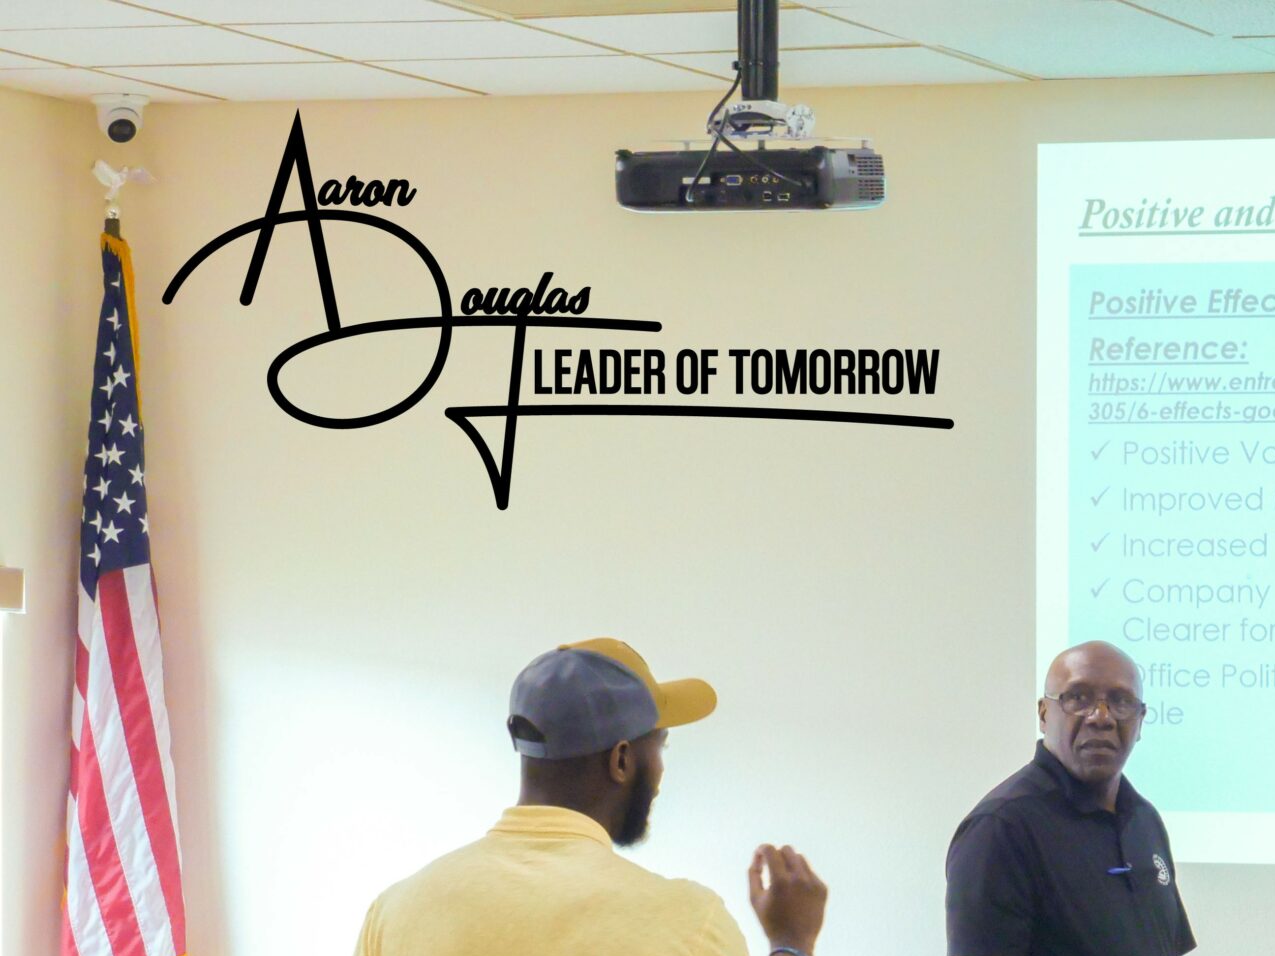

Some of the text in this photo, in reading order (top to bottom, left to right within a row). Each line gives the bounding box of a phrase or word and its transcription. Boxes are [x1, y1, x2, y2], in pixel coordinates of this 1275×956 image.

[1079, 196, 1204, 230] Positive
[1089, 289, 1197, 316] Positive
[1089, 336, 1248, 361] Reference:
[1122, 441, 1229, 465] Positive
[1123, 487, 1264, 516] Improved
[1123, 533, 1268, 558] Increased
[1122, 579, 1271, 608] Company
[1122, 618, 1230, 643] Clearer
[1144, 701, 1184, 725] ole
